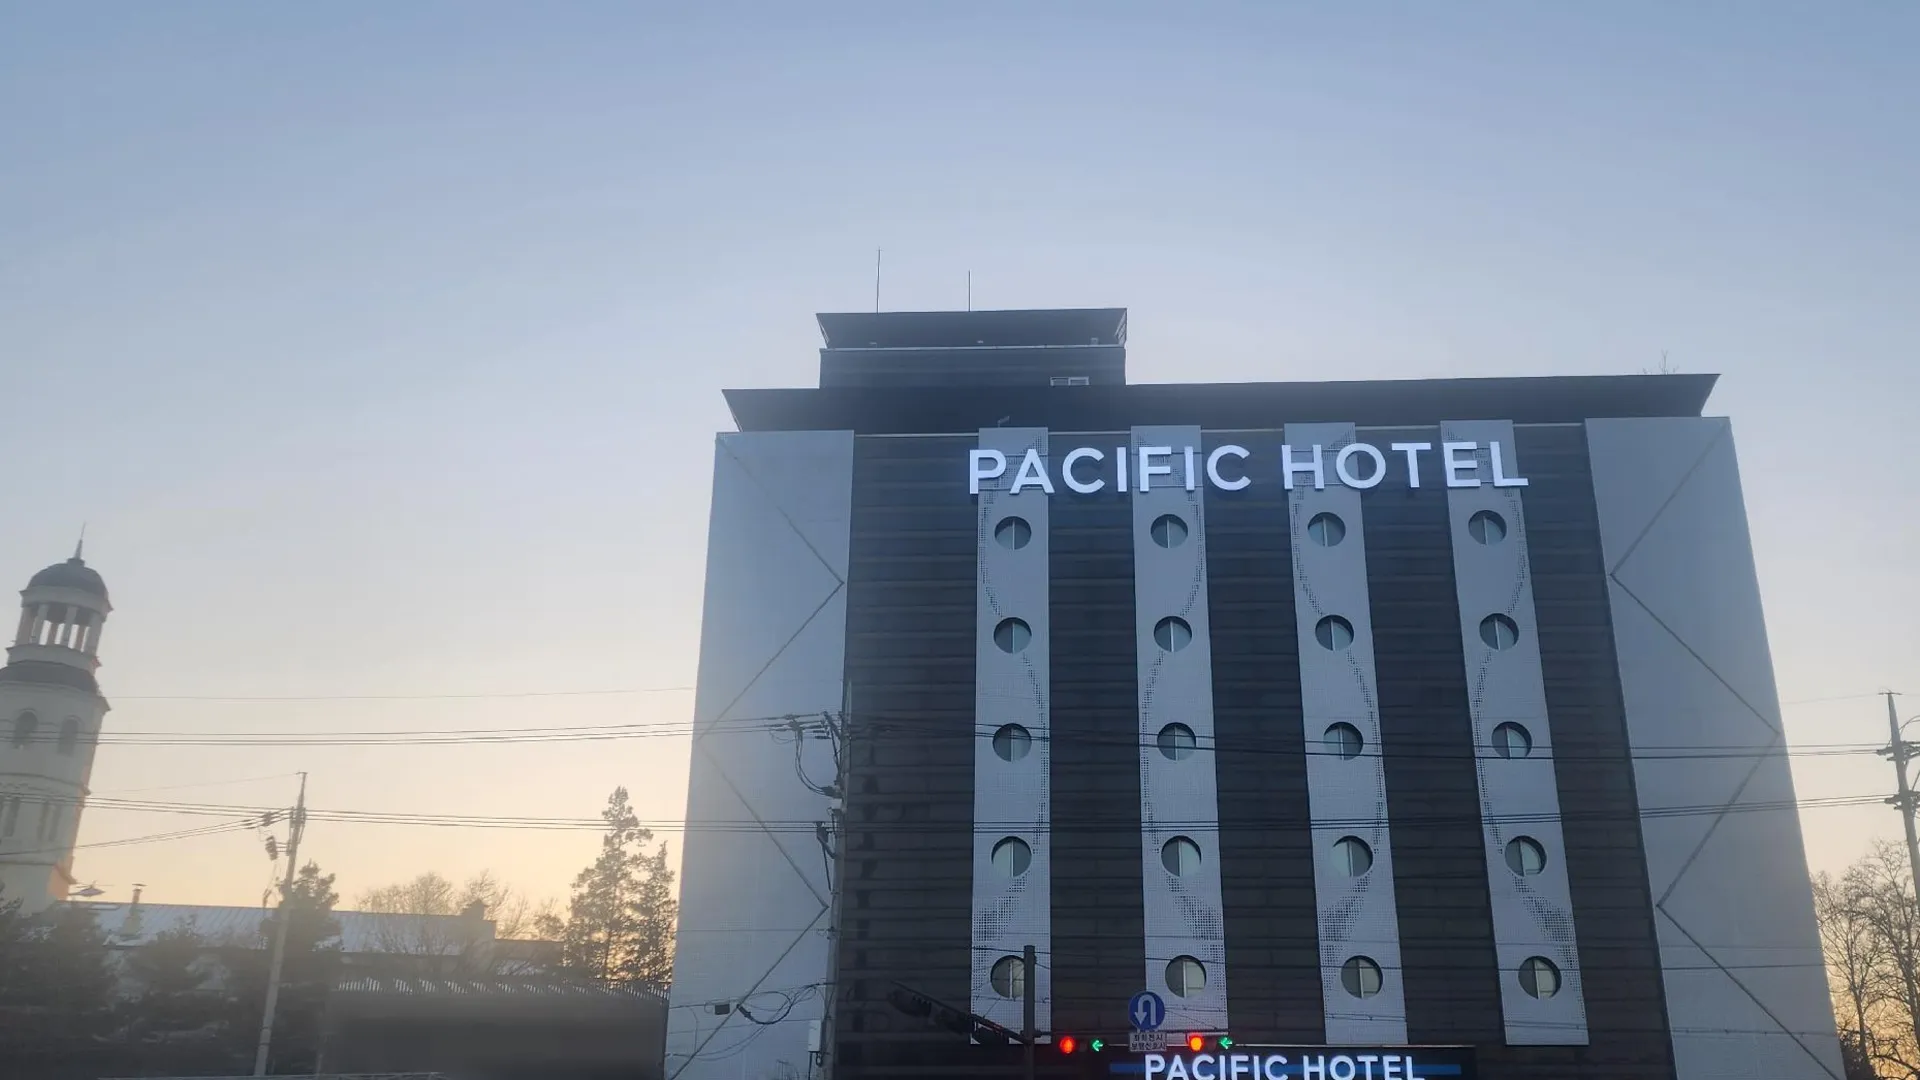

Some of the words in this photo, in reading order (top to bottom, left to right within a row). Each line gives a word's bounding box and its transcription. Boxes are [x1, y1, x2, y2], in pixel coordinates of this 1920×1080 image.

[969, 444, 1251, 495] PACIFIC
[1281, 441, 1529, 490] HOTEL
[1144, 1054, 1288, 1080] PACIFIC
[1303, 1055, 1426, 1080] HOTEL
